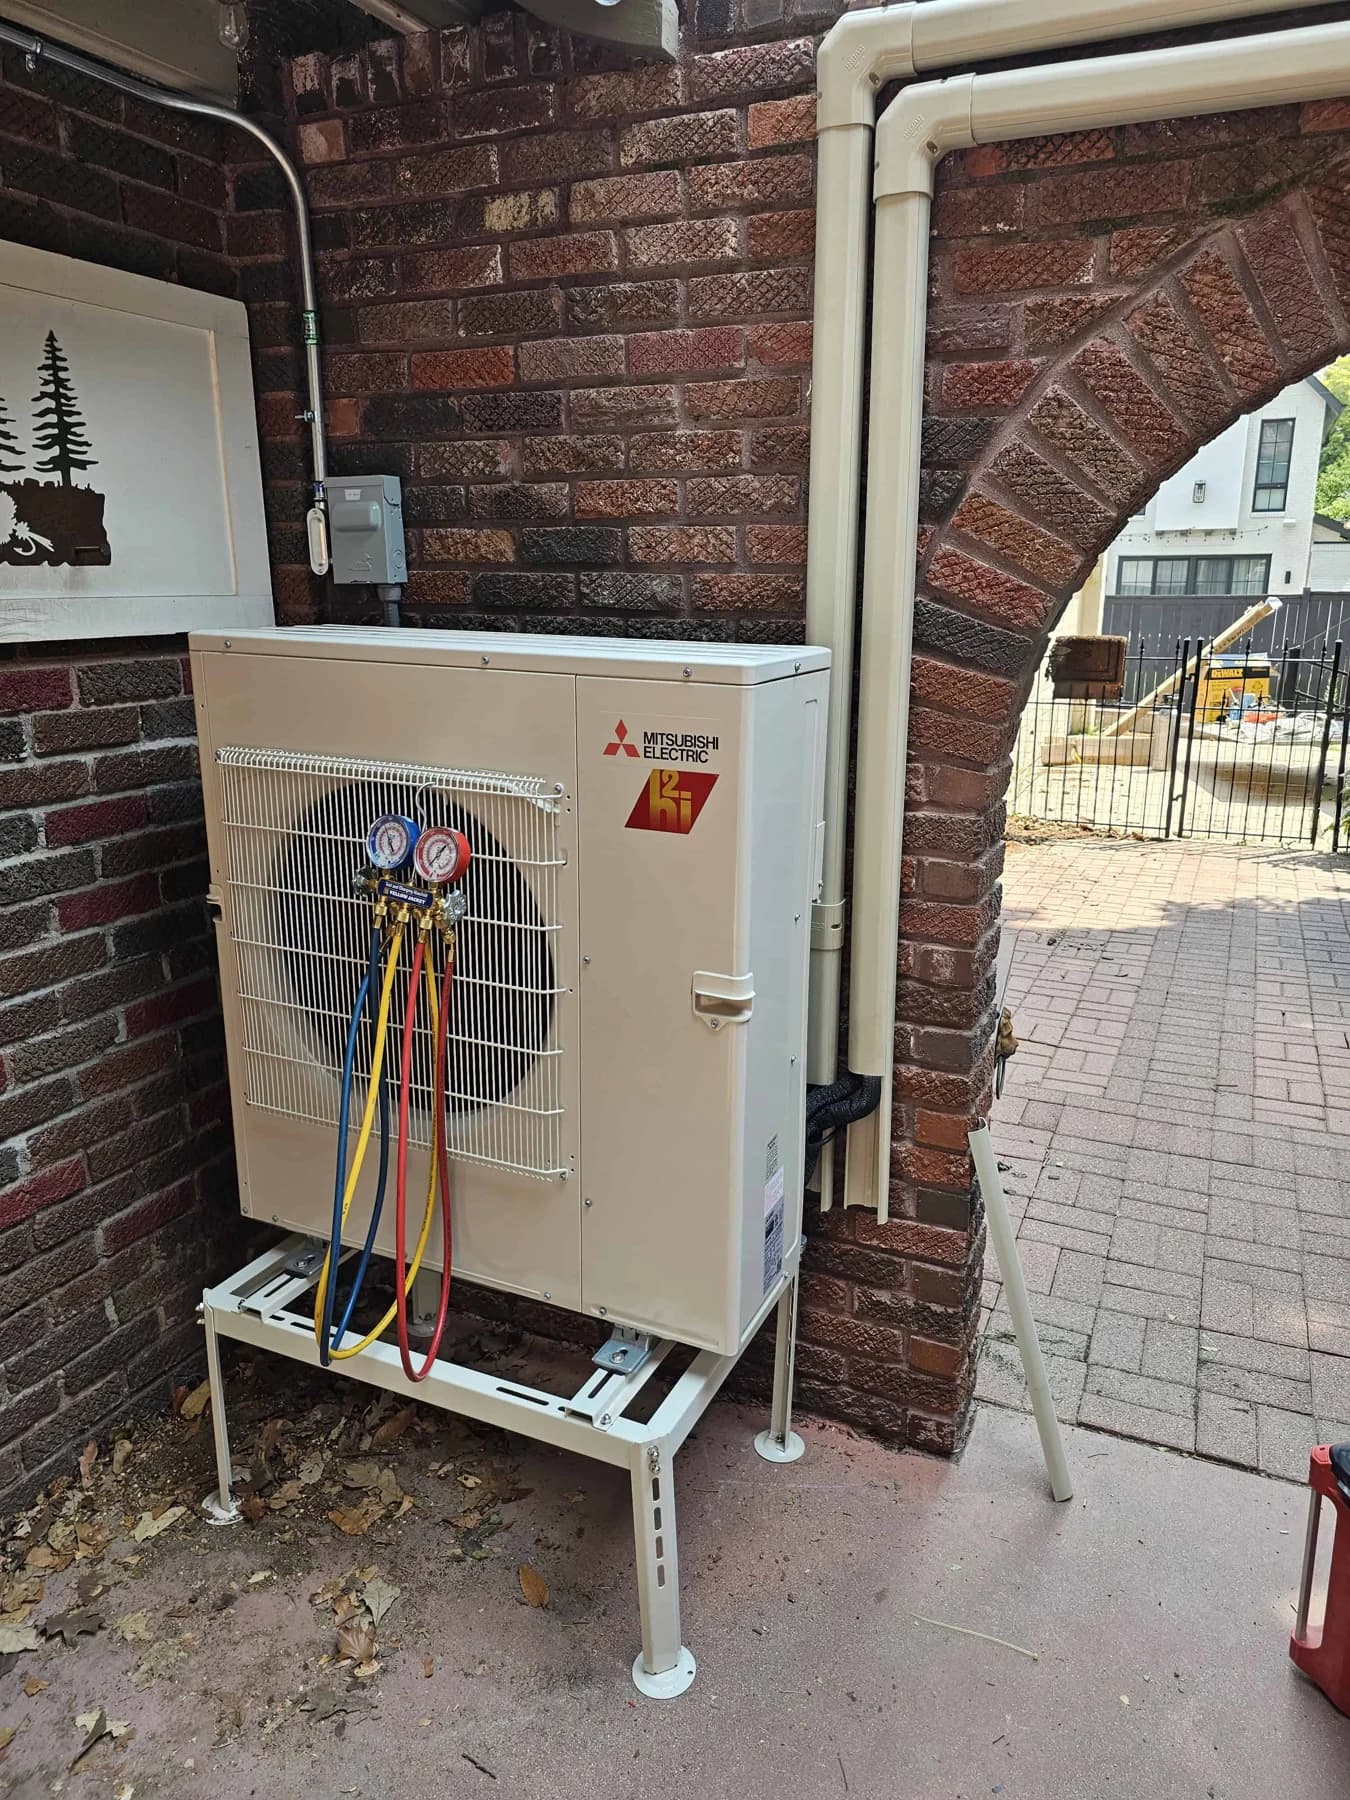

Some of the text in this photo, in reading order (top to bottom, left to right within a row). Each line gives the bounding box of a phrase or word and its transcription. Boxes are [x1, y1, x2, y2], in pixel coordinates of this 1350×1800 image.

[643, 731, 719, 750] MITSUBISHI
[643, 746, 708, 763] ELECTRIC
[390, 890, 426, 904] YELLOW JACKET
